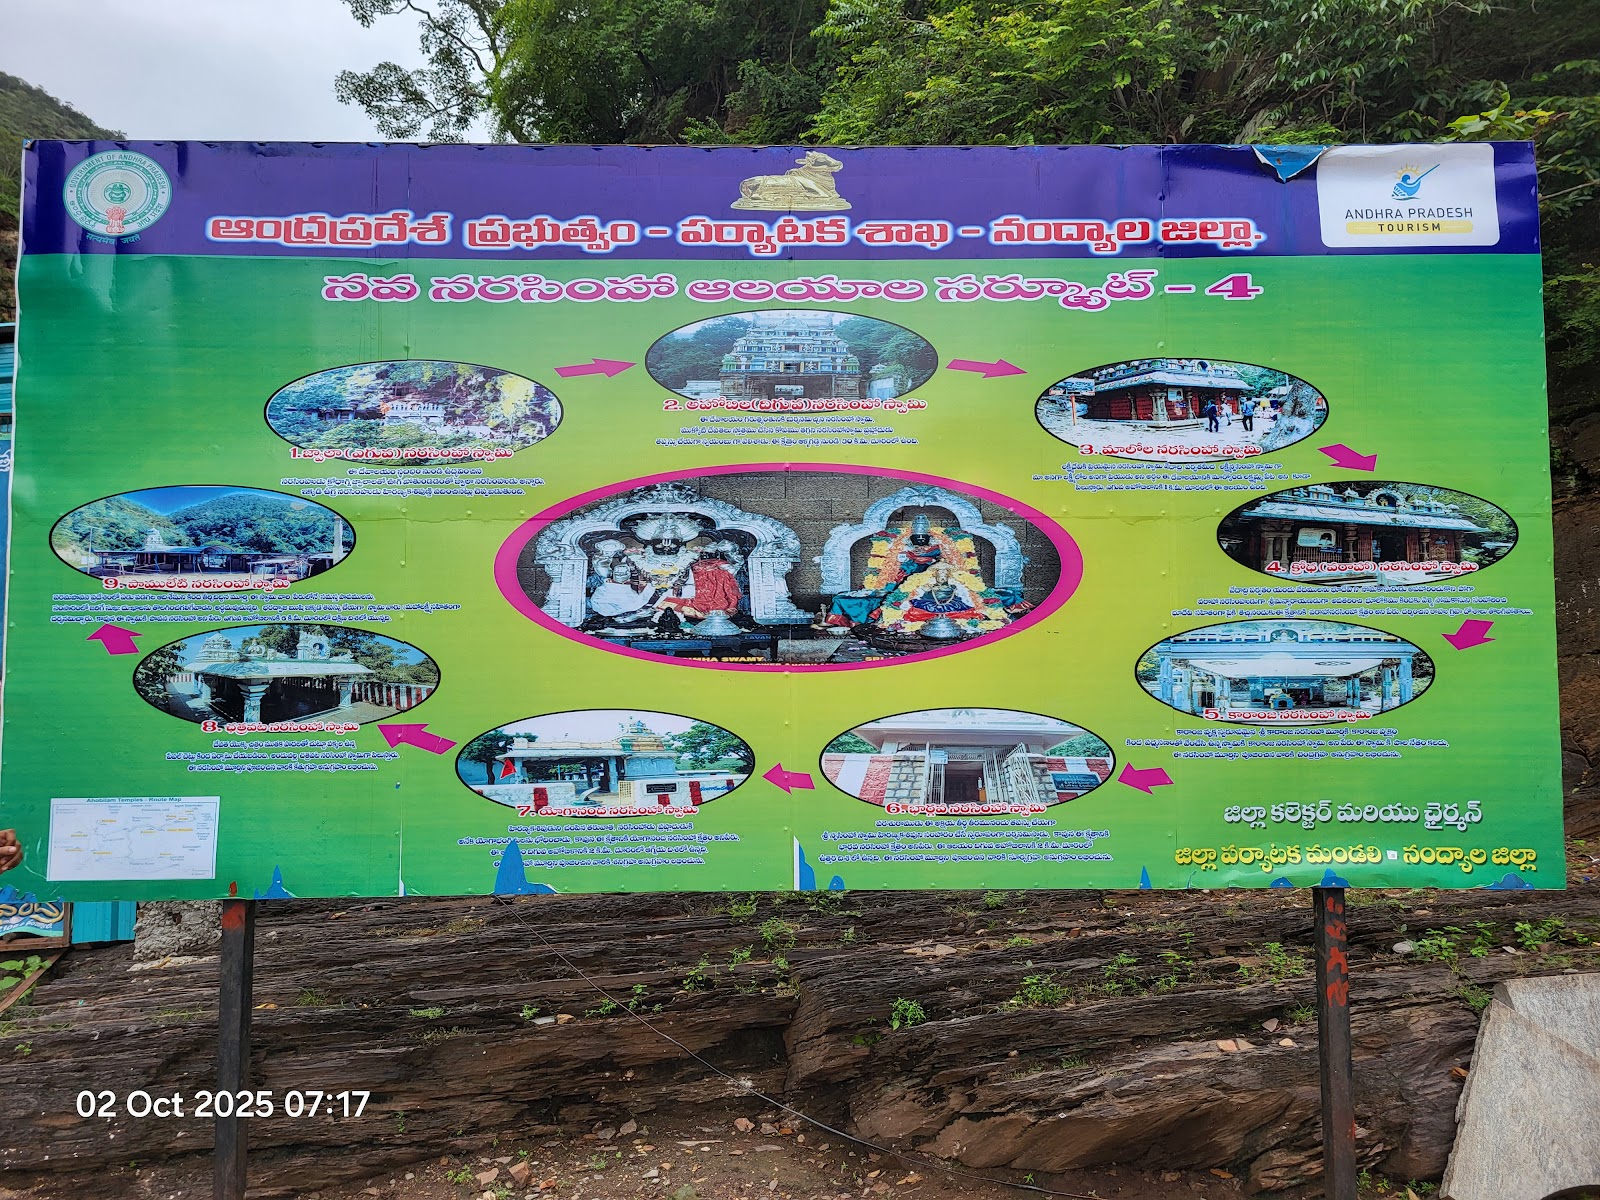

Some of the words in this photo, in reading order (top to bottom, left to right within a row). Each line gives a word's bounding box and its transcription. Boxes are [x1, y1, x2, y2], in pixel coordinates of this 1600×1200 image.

[69, 156, 105, 189] GOVERNMENT
[118, 154, 146, 167] ANDHRA
[146, 163, 168, 190] PRADESH
[1345, 208, 1404, 220] ANDHRA
[1408, 207, 1473, 218] PRADESH
[467, 216, 636, 251] ప్రభుత్వం
[681, 217, 847, 253] పర్యాటక
[856, 221, 950, 247] శాఖ
[993, 218, 1150, 252] నంద్యాల
[1378, 223, 1441, 232] TOURISM
[323, 274, 418, 301] నవ
[430, 274, 677, 302] నరసింహా
[686, 275, 927, 302] ఆలయాల
[1205, 274, 1263, 300] 4
[883, 398, 926, 414] స్వామి
[404, 447, 470, 458] నరసింహా
[472, 447, 513, 462] స్వామి
[1079, 443, 1099, 455] 3.
[1101, 442, 1154, 455] మాలోల
[1156, 443, 1219, 456] నరసింహా
[1222, 444, 1262, 459] స్వామి
[1265, 561, 1286, 573] 4.
[1379, 561, 1438, 572] నరసింహా
[1441, 561, 1478, 575] స్వామి
[103, 577, 124, 589] 9.
[191, 578, 250, 589] నరసింహా
[253, 579, 289, 592] స్వామి
[1204, 708, 1224, 720] 5.
[1279, 710, 1335, 720] నరసింహా
[1337, 710, 1371, 723] స్వామి
[202, 720, 221, 732] 8.
[270, 722, 323, 732] నరసింహా
[325, 722, 359, 735] స్వామి
[516, 805, 536, 817] 7.
[609, 805, 663, 815] నరసింహా
[665, 805, 698, 818] స్వామి
[885, 803, 905, 814] 6.
[949, 803, 1007, 814] నరసింహా
[1009, 804, 1046, 816] స్వామి
[1223, 802, 1267, 828] జిల్లా
[1270, 799, 1333, 829] కలెక్టర్
[1336, 802, 1420, 823] మరియు
[1174, 845, 1217, 871] జిల్లా
[1221, 843, 1302, 873] పర్యాటక
[1305, 845, 1382, 865] మండలి
[1402, 843, 1487, 873] నంద్యాల
[1491, 844, 1537, 871] జిల్లా
